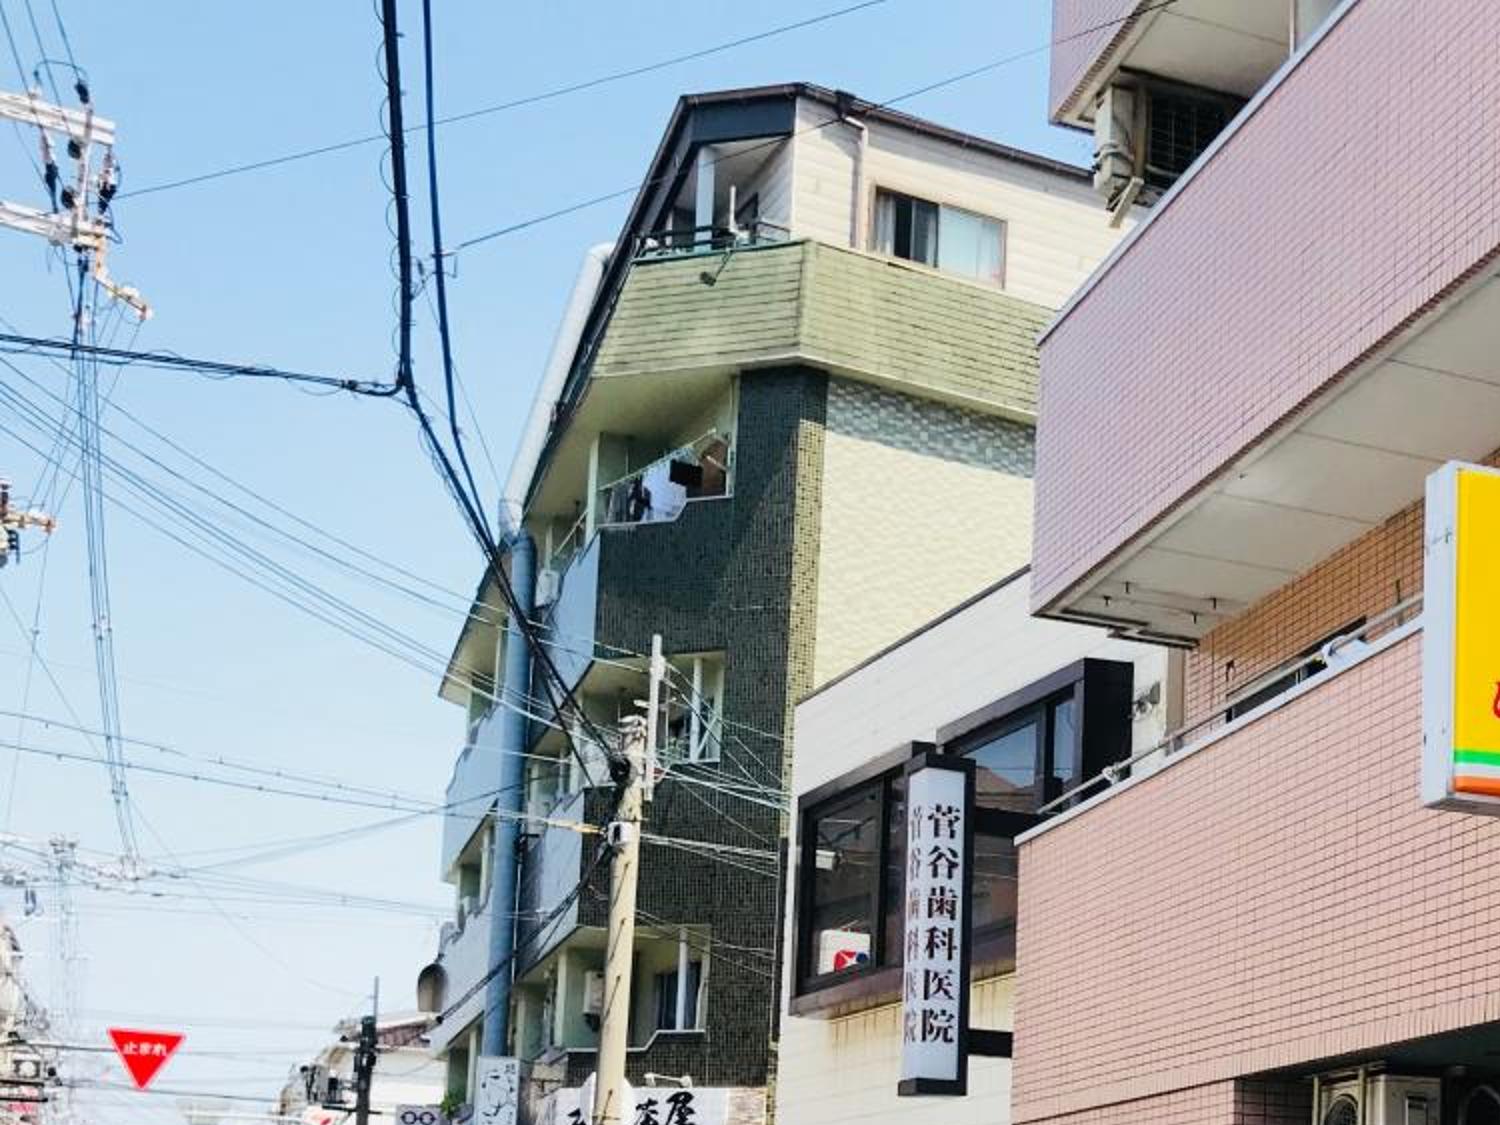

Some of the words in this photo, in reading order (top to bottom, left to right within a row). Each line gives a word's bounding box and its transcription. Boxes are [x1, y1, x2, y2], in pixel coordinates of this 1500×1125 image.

[920, 803, 961, 1044] 菅谷歯科医院
[122, 1041, 168, 1057] 止まれ
